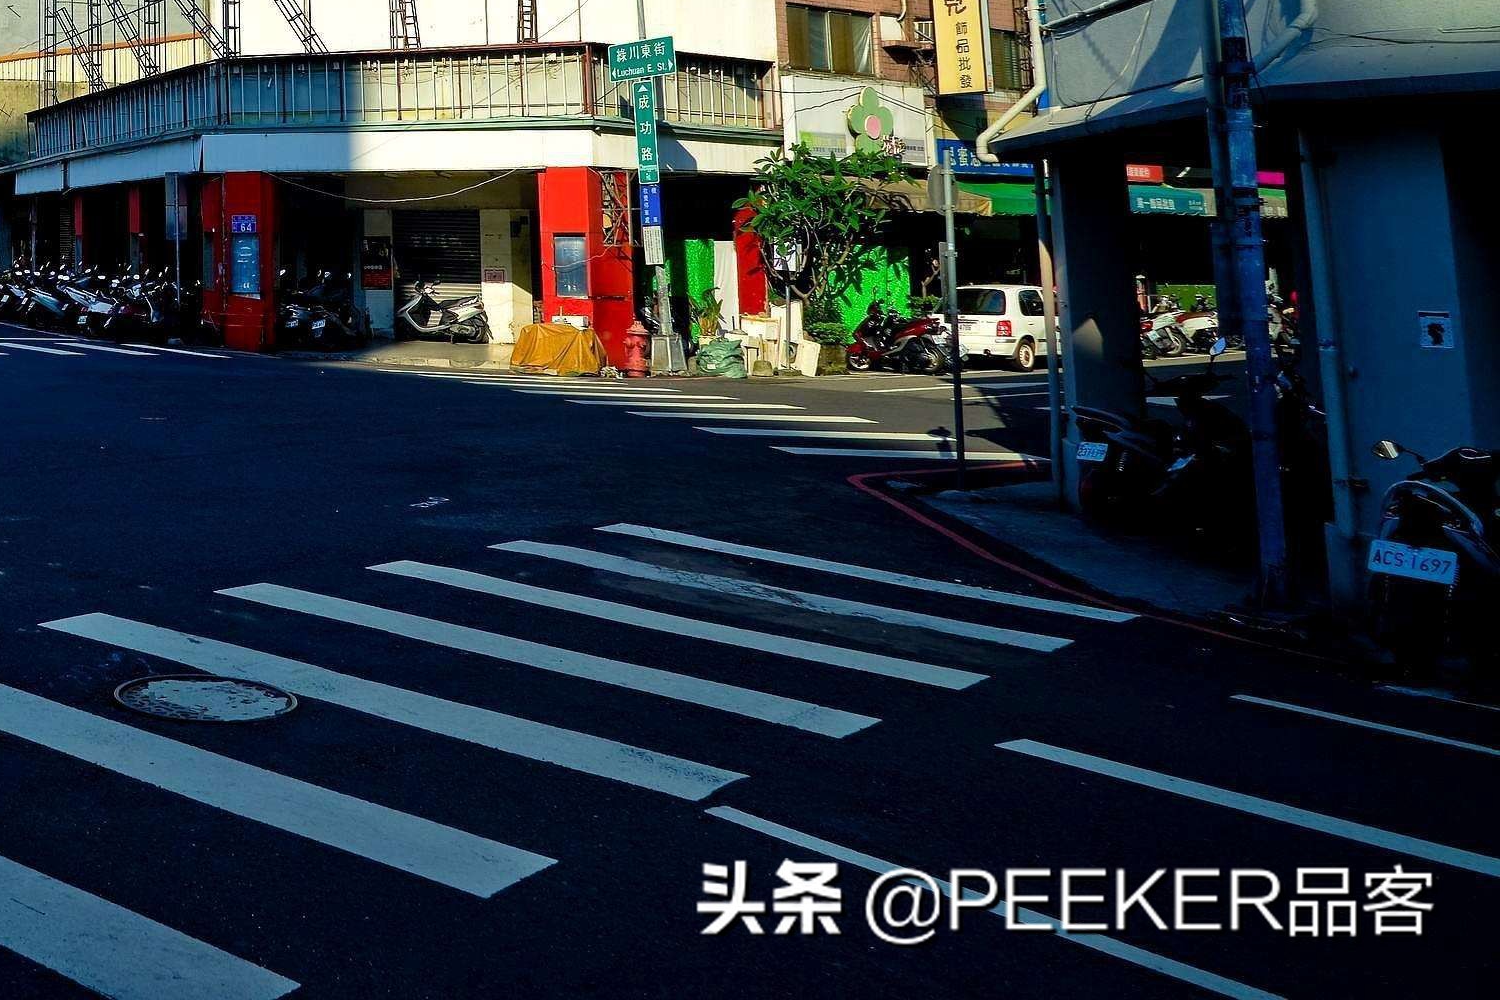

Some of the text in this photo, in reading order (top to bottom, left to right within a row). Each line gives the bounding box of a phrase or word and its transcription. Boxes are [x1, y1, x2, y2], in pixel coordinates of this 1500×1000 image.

[616, 41, 666, 63] 綠川東街
[955, 21, 973, 89] 飾品批發
[638, 95, 653, 161] 成功路
[240, 222, 252, 232] 64
